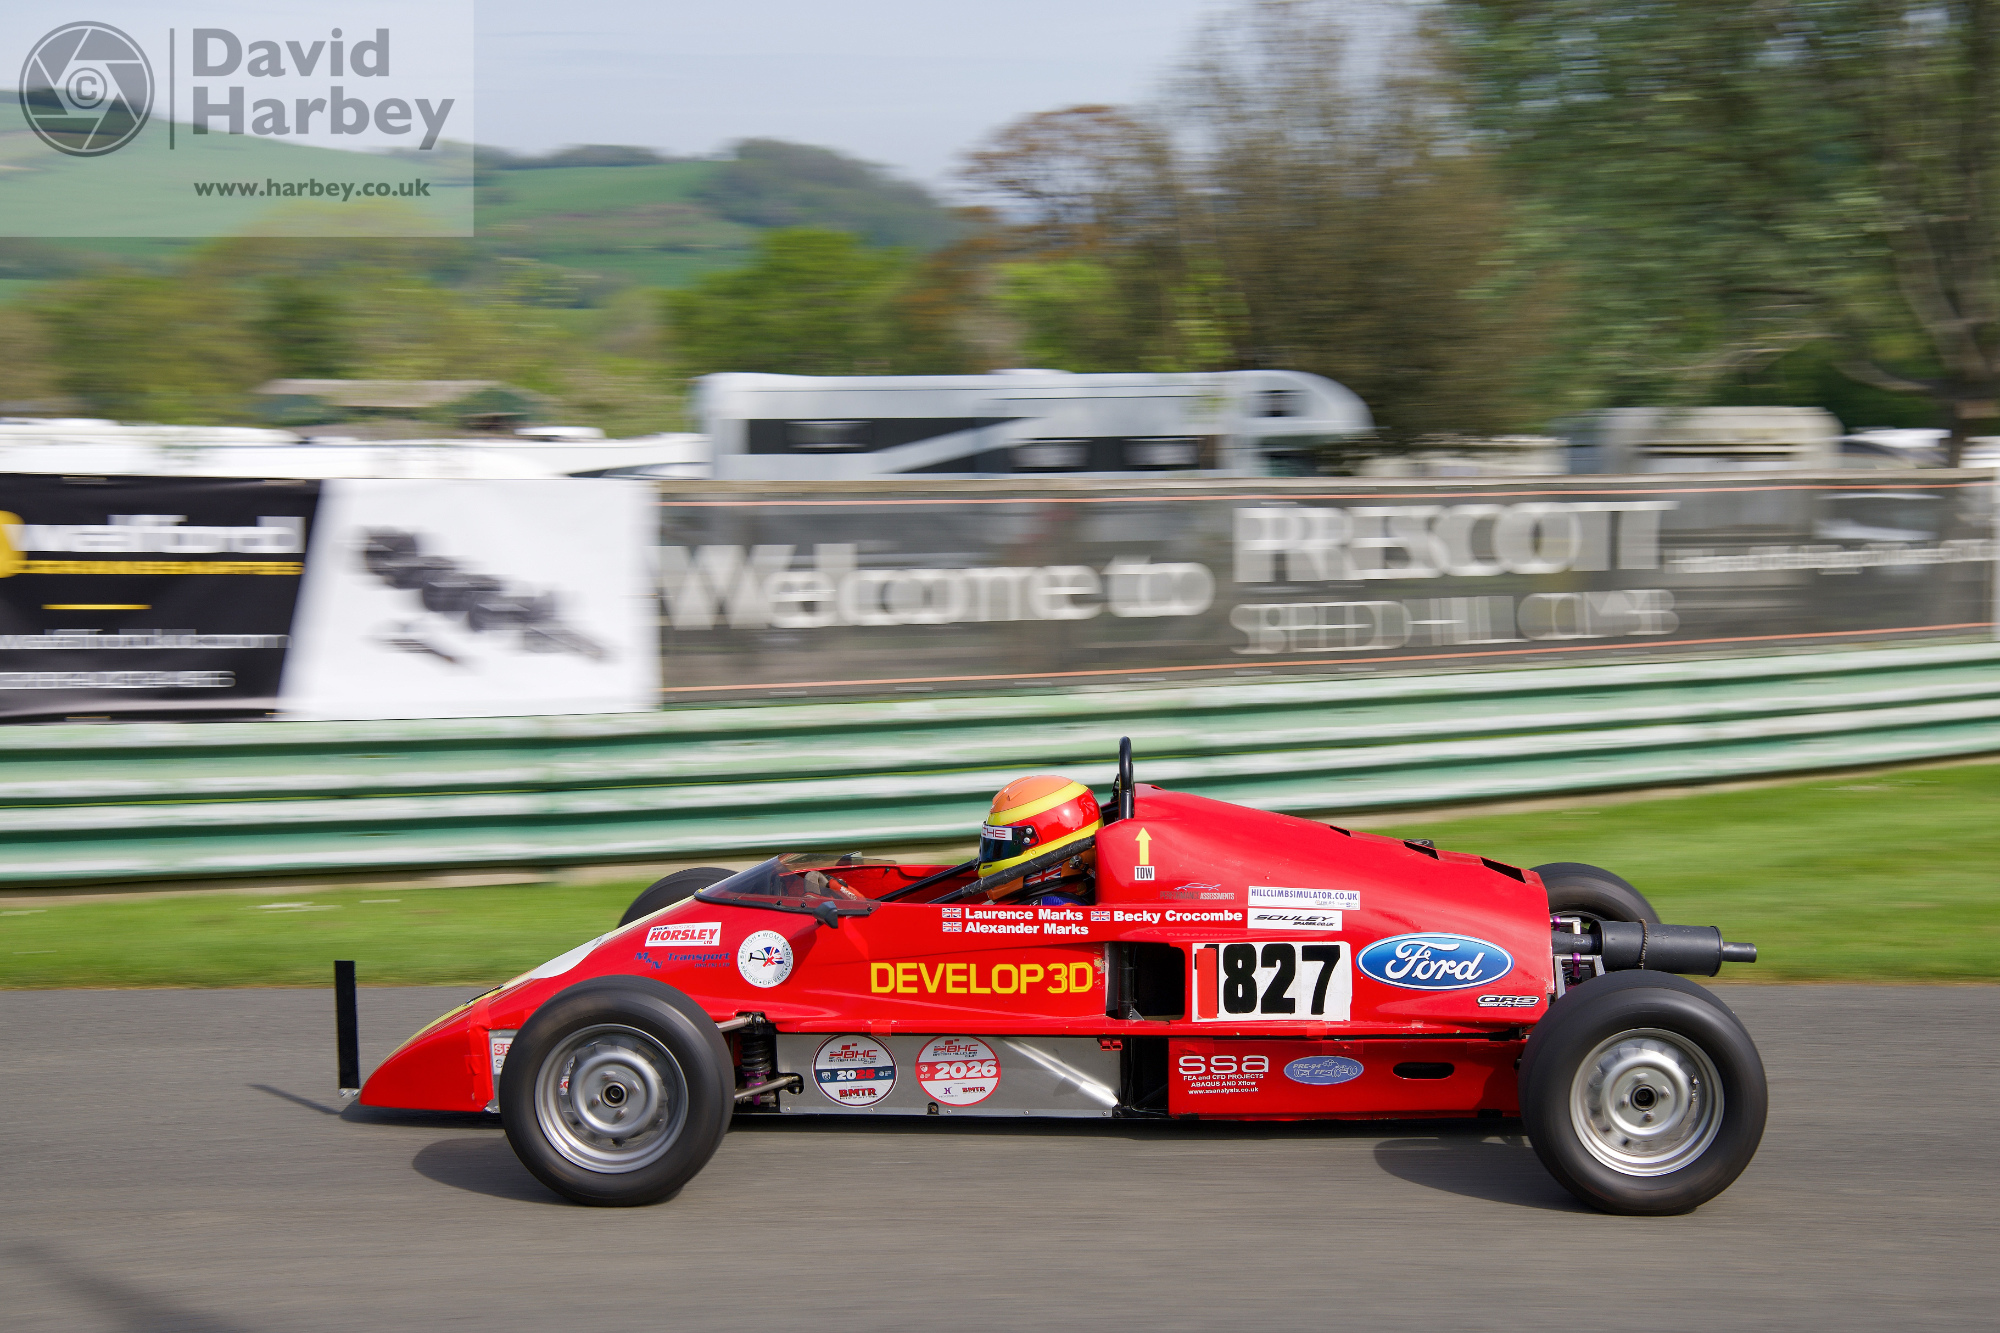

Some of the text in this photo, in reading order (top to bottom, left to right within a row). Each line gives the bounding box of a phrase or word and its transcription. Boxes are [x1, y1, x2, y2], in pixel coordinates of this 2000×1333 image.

[1234, 501, 1680, 583] PRESCOTT
[645, 543, 1215, 630] Welcome to
[1136, 867, 1153, 879] TOW
[1251, 888, 1358, 900] HILLCLIMBSIMULATOR.CO.UK
[965, 908, 1084, 920] Laurence Marks
[1114, 910, 1242, 924] Becky Crocombe
[649, 928, 718, 942] HORSLEY
[965, 922, 1089, 935] Alexander Marks
[740, 935, 757, 959] BRITISH
[634, 952, 731, 970] M&N Transport
[1385, 941, 1485, 980] Ford
[762, 970, 788, 986] DRIVERS
[1479, 996, 1539, 1004] QRS
[934, 1060, 997, 1080] 2026
[1178, 1055, 1269, 1074] ssa
[837, 1069, 876, 1080] 2025
[839, 1088, 877, 1098] BMTR
